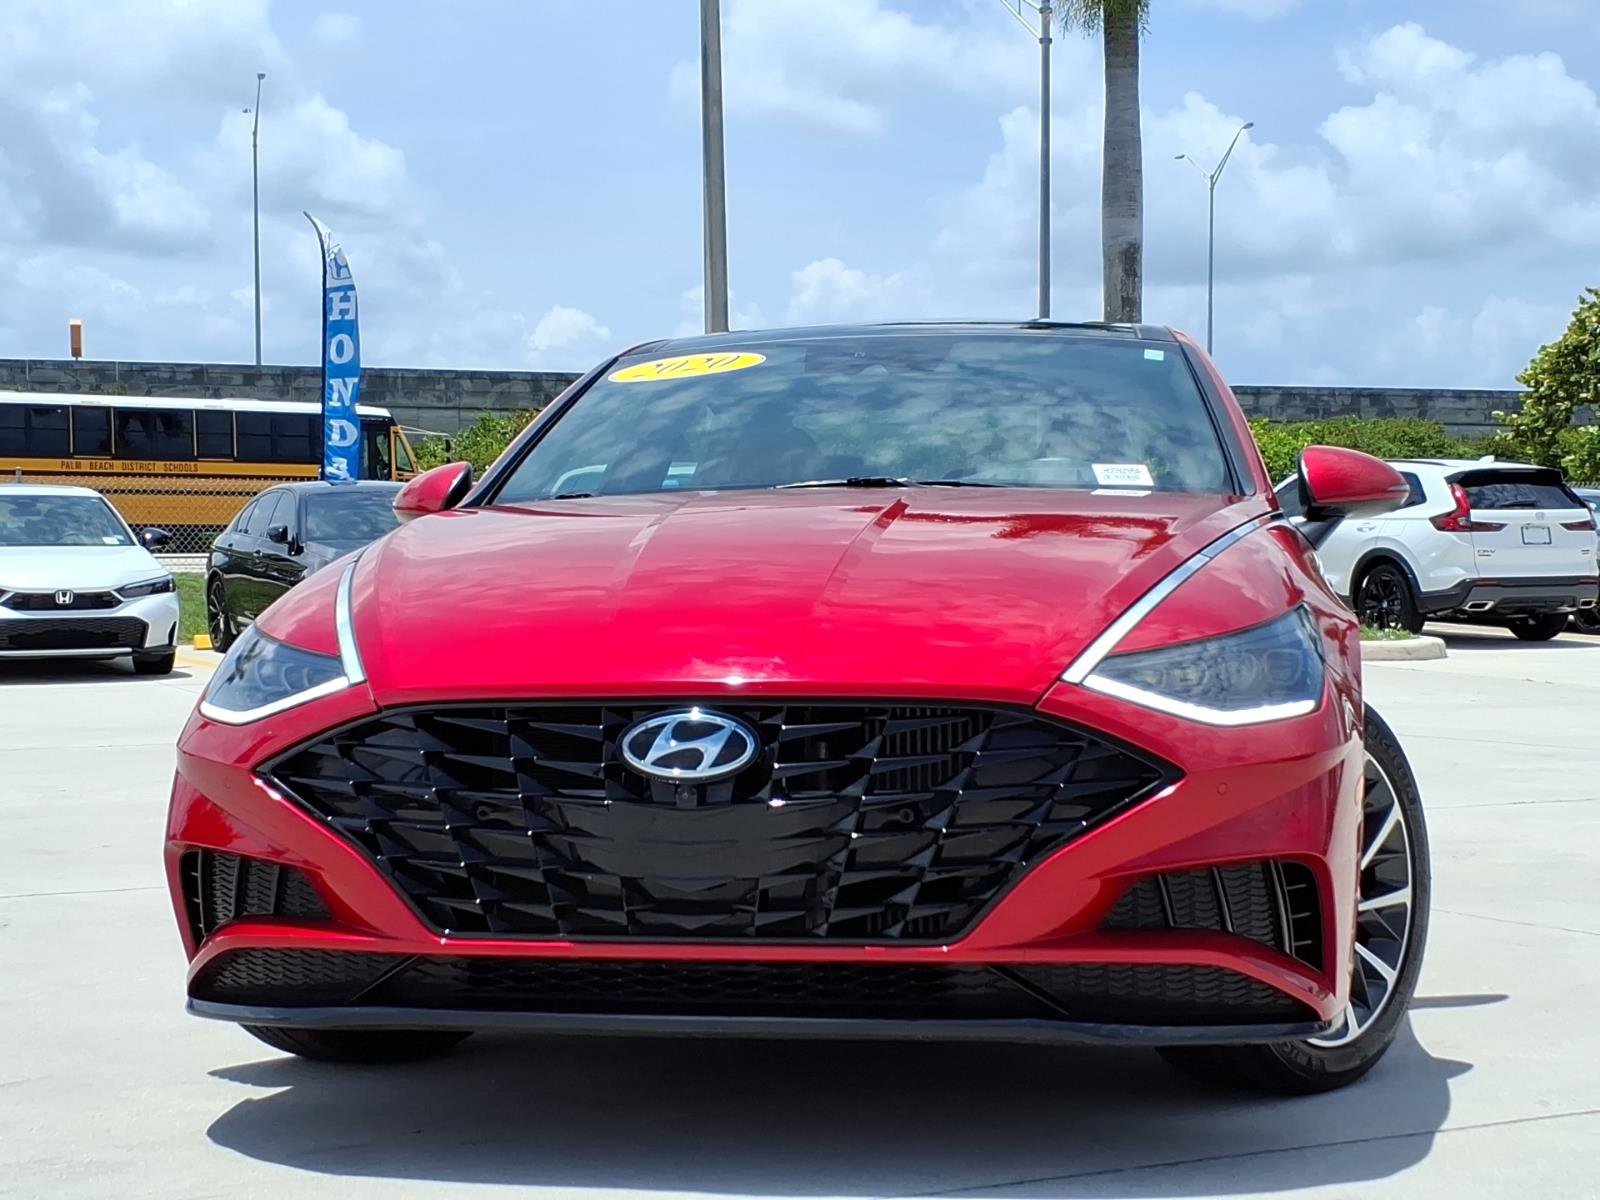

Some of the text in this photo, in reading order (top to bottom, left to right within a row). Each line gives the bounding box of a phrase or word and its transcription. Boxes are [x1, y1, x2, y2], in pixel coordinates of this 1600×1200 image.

[631, 355, 740, 377] 2020
[60, 461, 199, 473] PALM BEACH DISTRICT SCHOOLS
